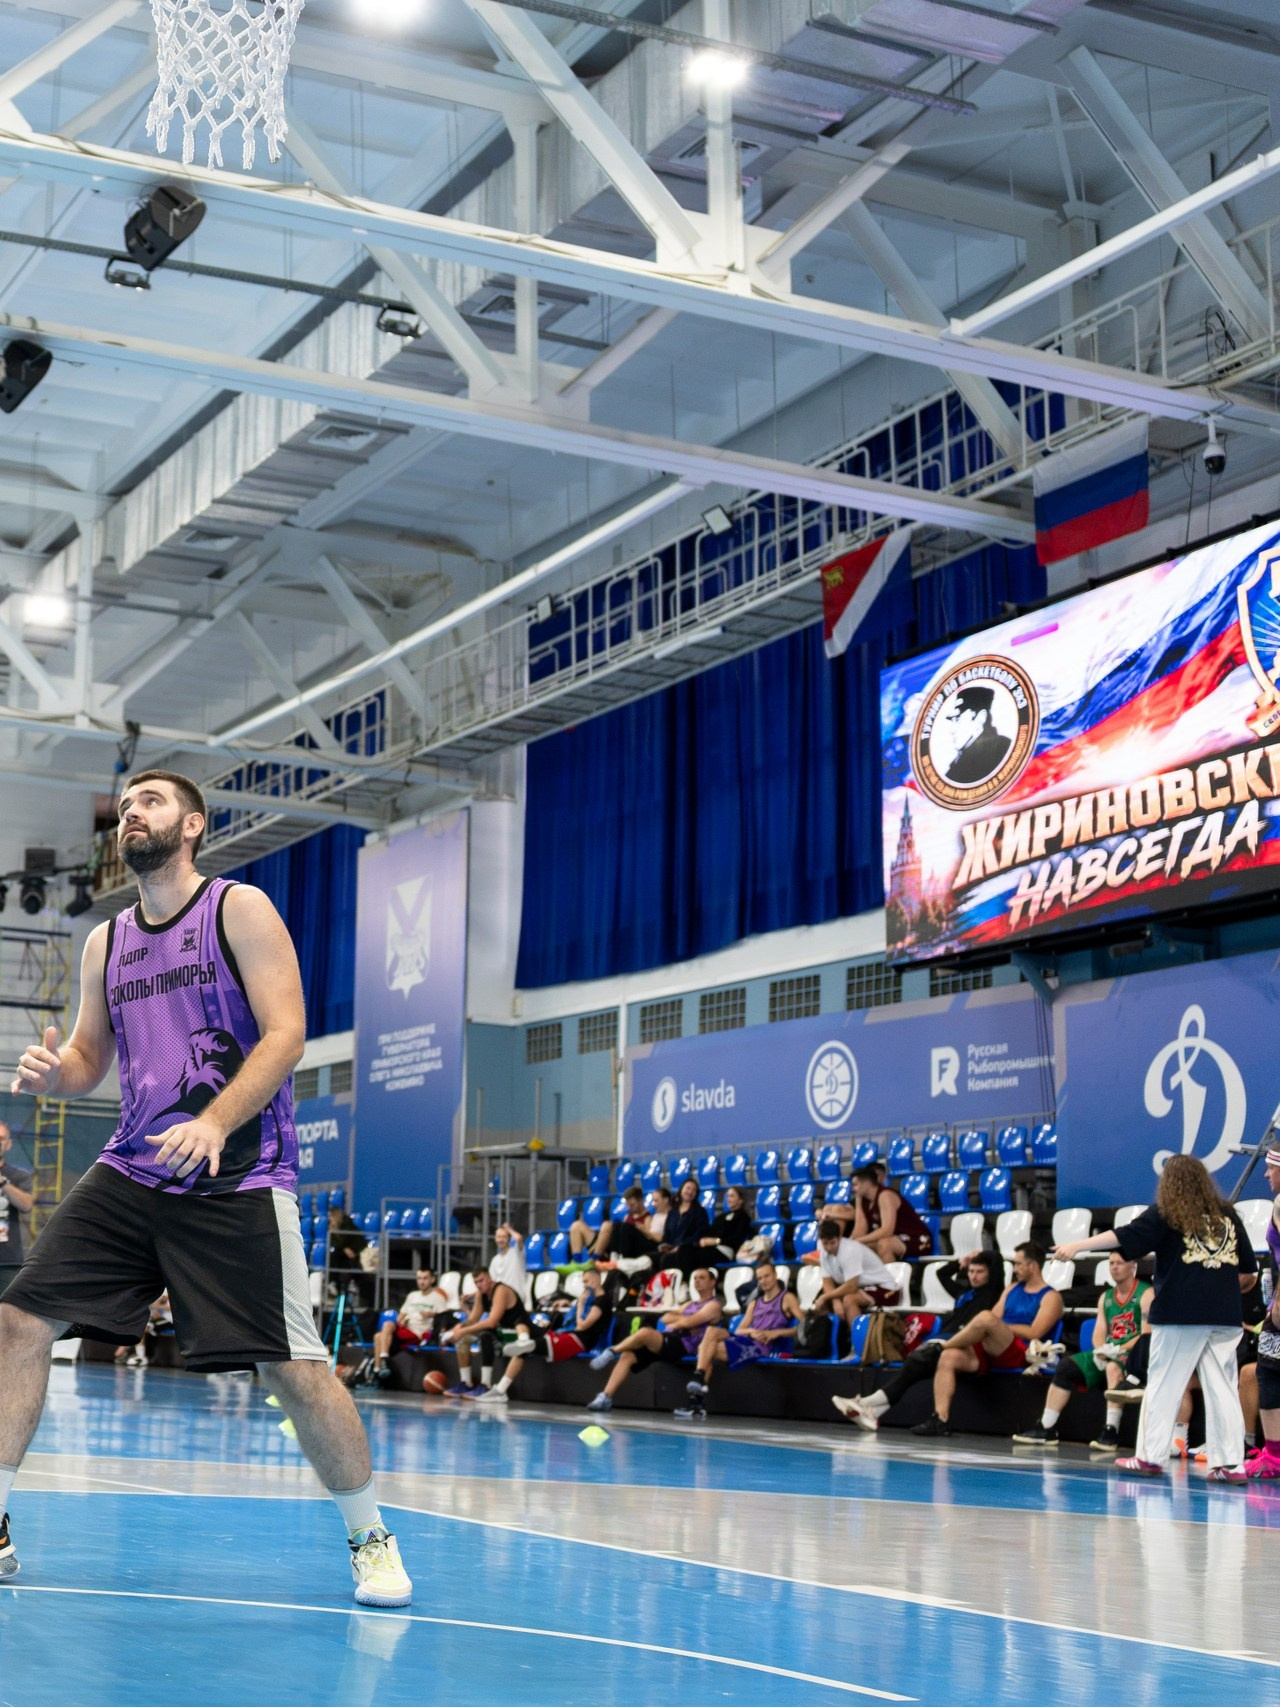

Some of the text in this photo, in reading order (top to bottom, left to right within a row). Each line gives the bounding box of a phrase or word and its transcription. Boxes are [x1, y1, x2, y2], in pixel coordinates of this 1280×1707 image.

[943, 680, 959, 697] ПО
[1007, 800, 1270, 932] НАВСЕГДА
[116, 947, 148, 969] ЛДПР
[109, 961, 218, 1009] СОКОЛЫ ПРИМОРЬЯ
[967, 1043, 1009, 1060] Русская
[967, 1076, 1019, 1092] Компания
[682, 1079, 735, 1113] slavda
